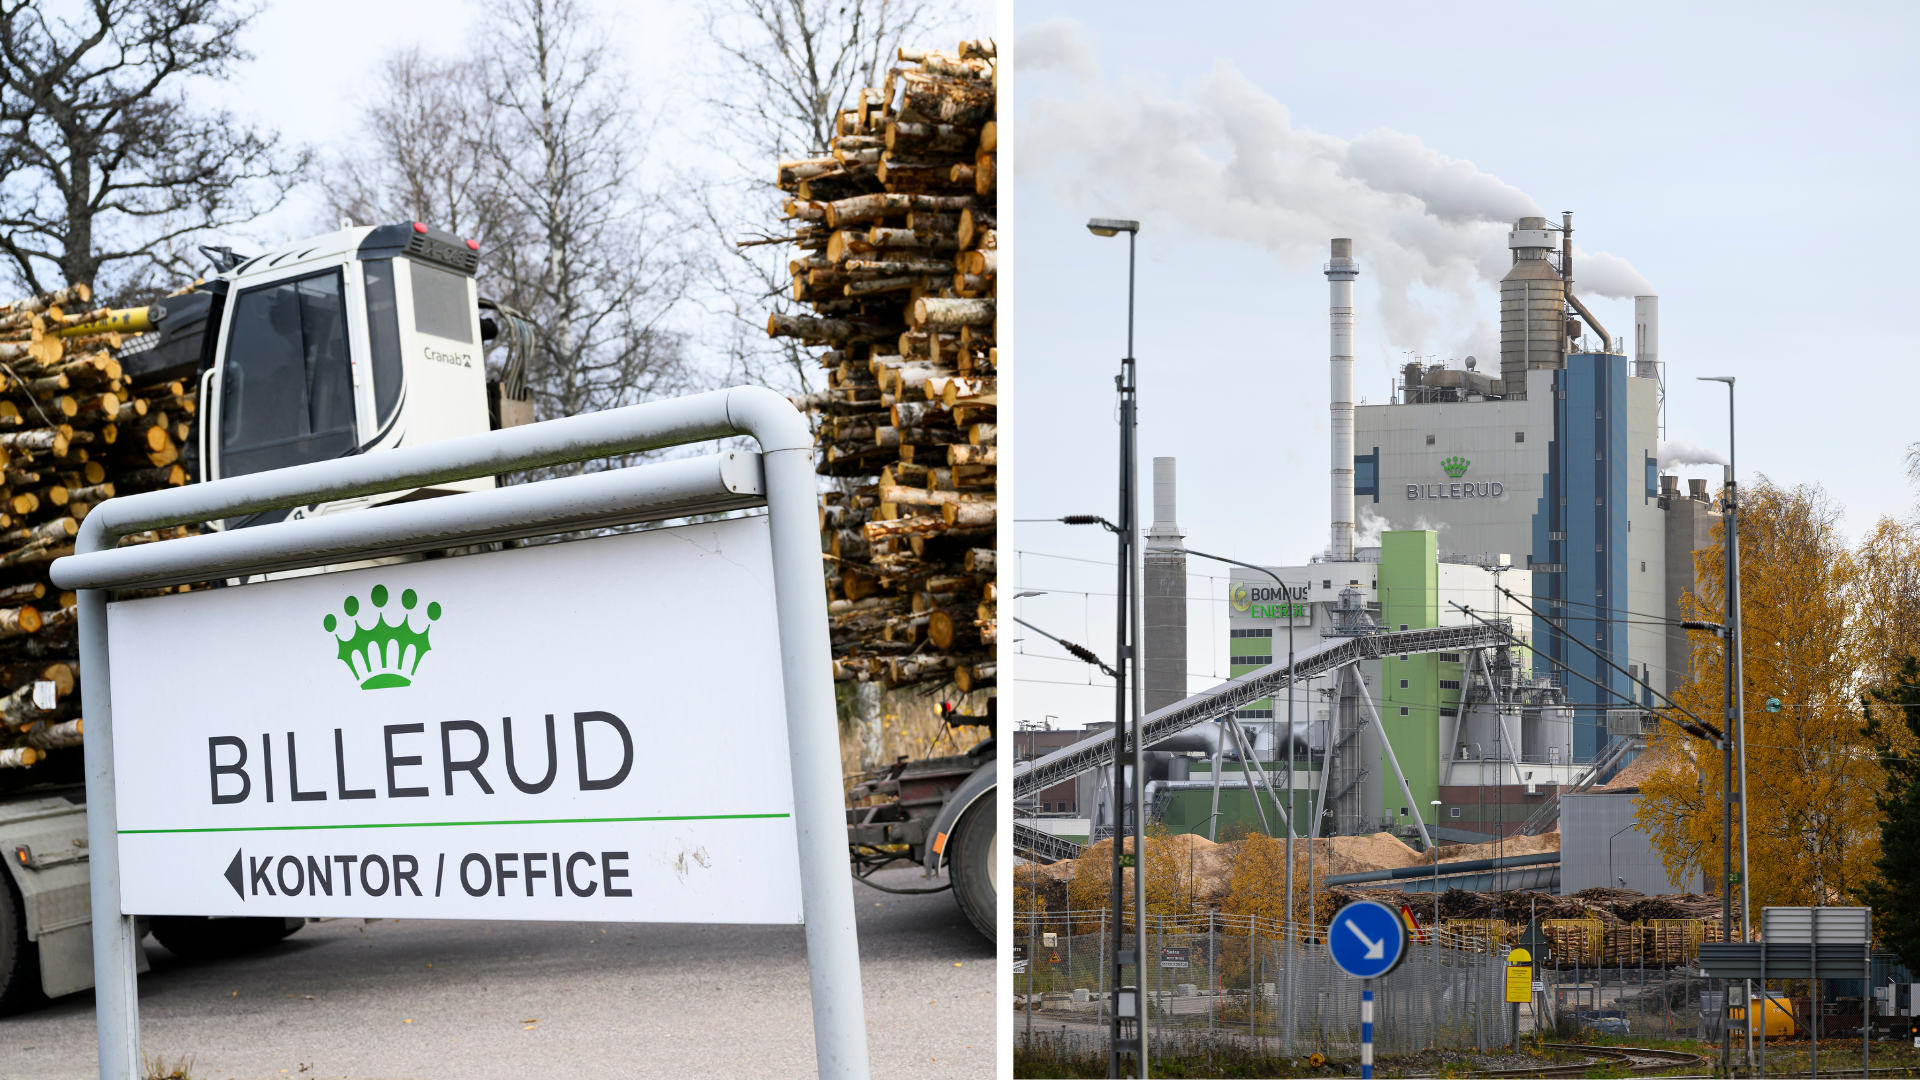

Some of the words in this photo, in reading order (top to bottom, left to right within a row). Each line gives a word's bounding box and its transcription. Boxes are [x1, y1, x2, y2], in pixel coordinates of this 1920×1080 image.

[424, 346, 462, 366] Cranab
[1406, 482, 1504, 500] BILLERUD
[1251, 604, 1303, 618] ENERGI
[208, 710, 634, 805] BILLERUD
[249, 854, 423, 897] KONTOR
[435, 853, 445, 897] /
[460, 851, 633, 897] OFFICE
[1728, 873, 1739, 881] 25
